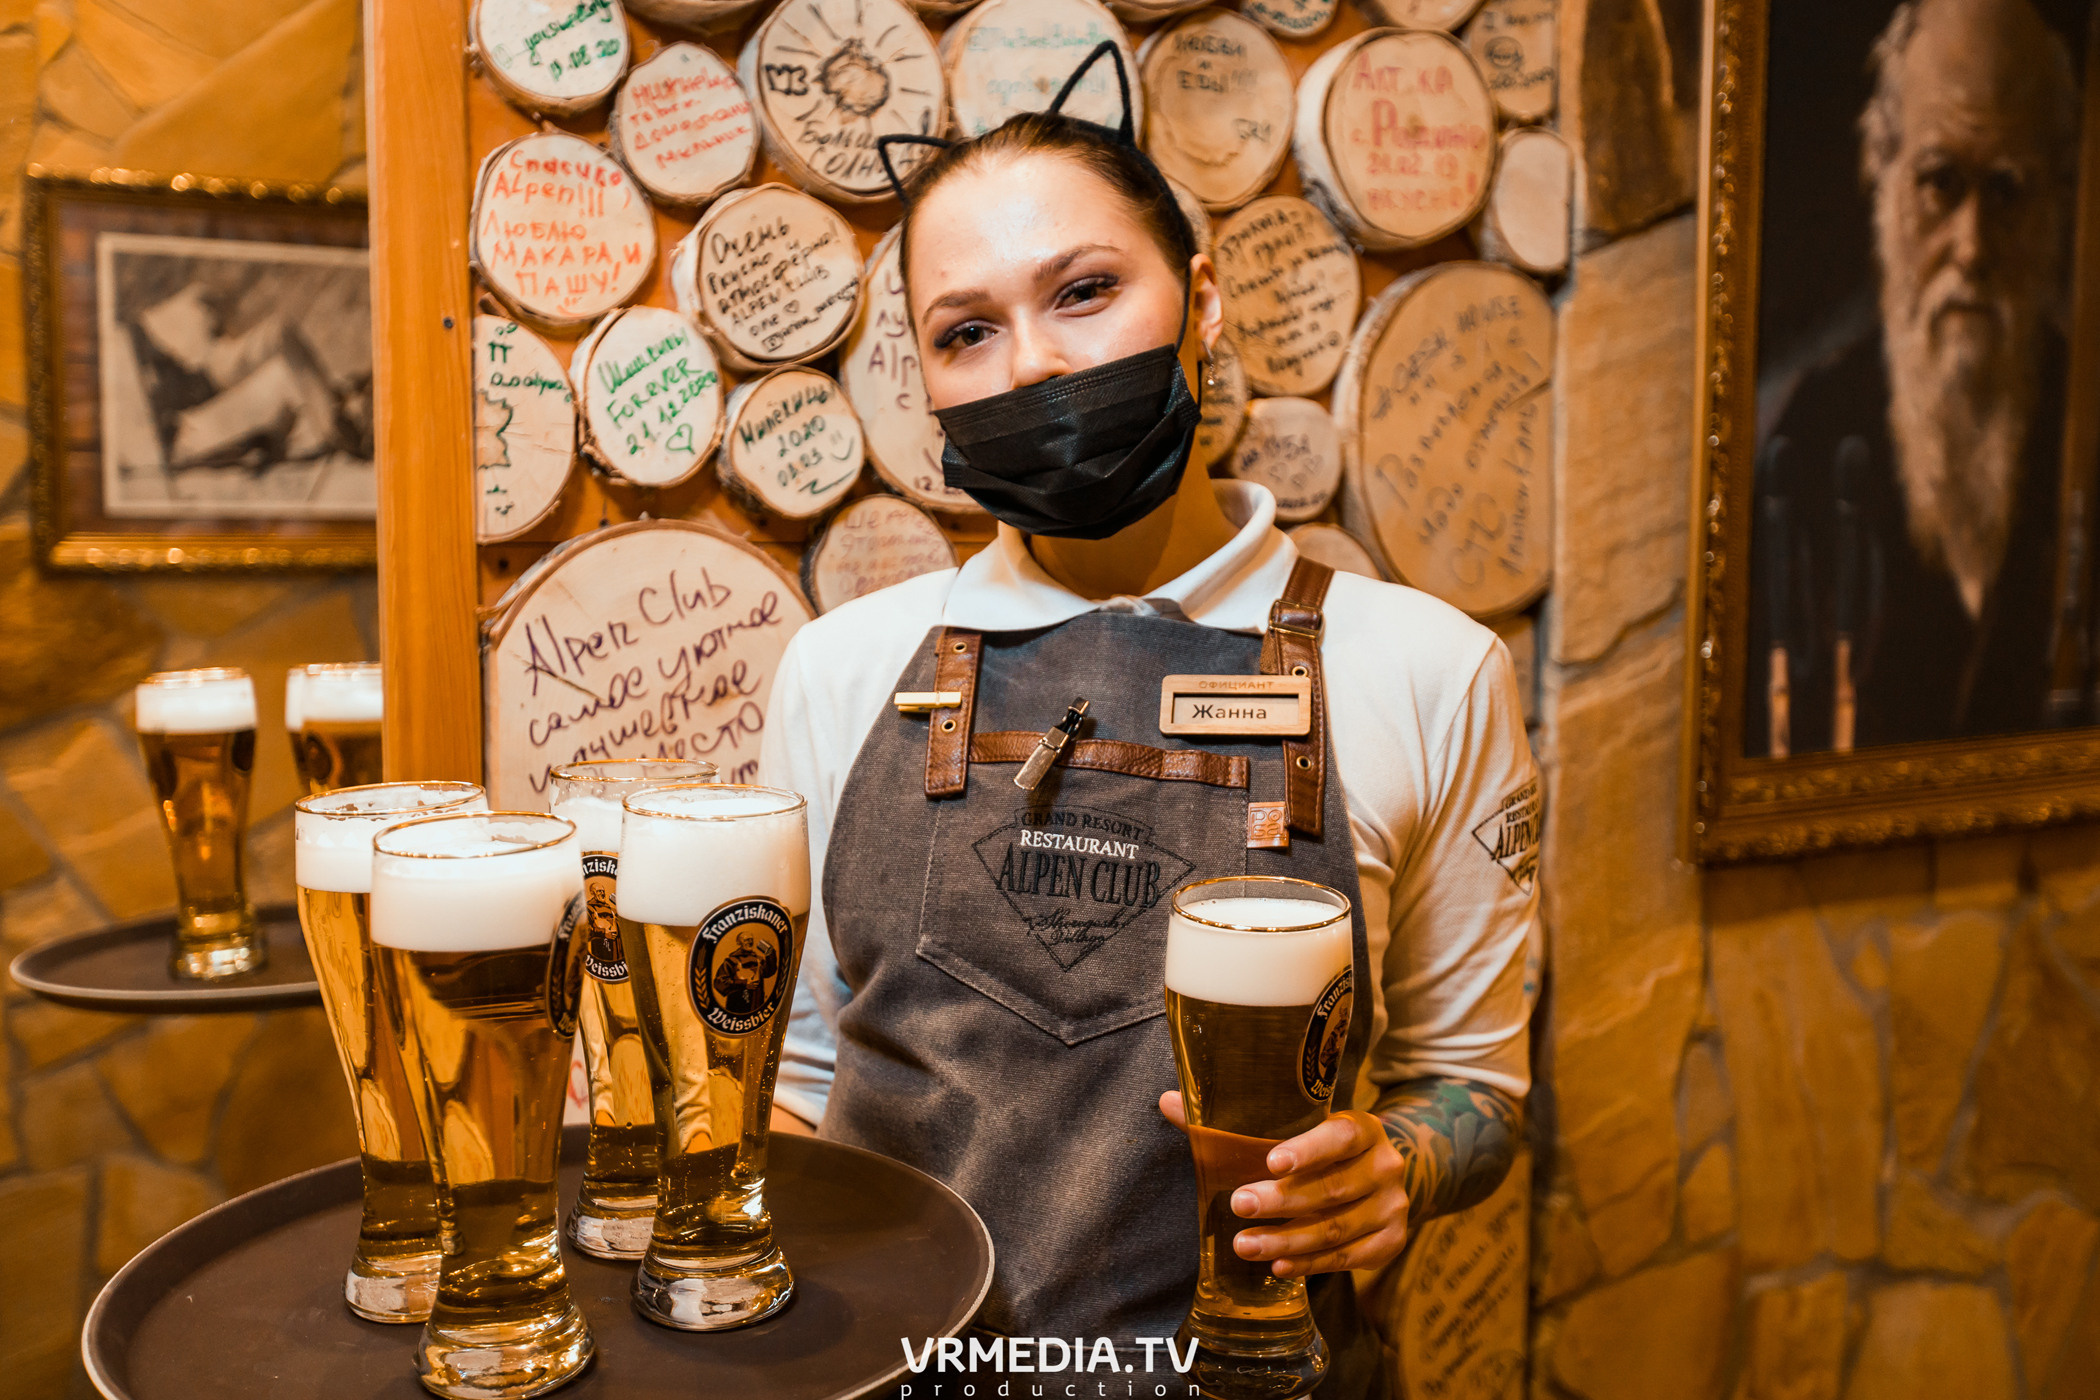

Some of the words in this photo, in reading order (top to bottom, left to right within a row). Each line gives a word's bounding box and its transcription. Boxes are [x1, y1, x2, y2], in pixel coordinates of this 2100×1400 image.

[639, 566, 732, 625] Club
[1198, 680, 1275, 690] ОФИЦИАНТ
[1192, 704, 1268, 720] Жанна
[1021, 812, 1077, 828] GRAND
[1081, 814, 1145, 841] RESORT
[1020, 829, 1139, 860] RESTAURANT
[996, 842, 1086, 900] ALPEN
[1090, 859, 1162, 909] CLUB
[702, 904, 789, 944] Franziskaner
[706, 1001, 775, 1032] Weissbier
